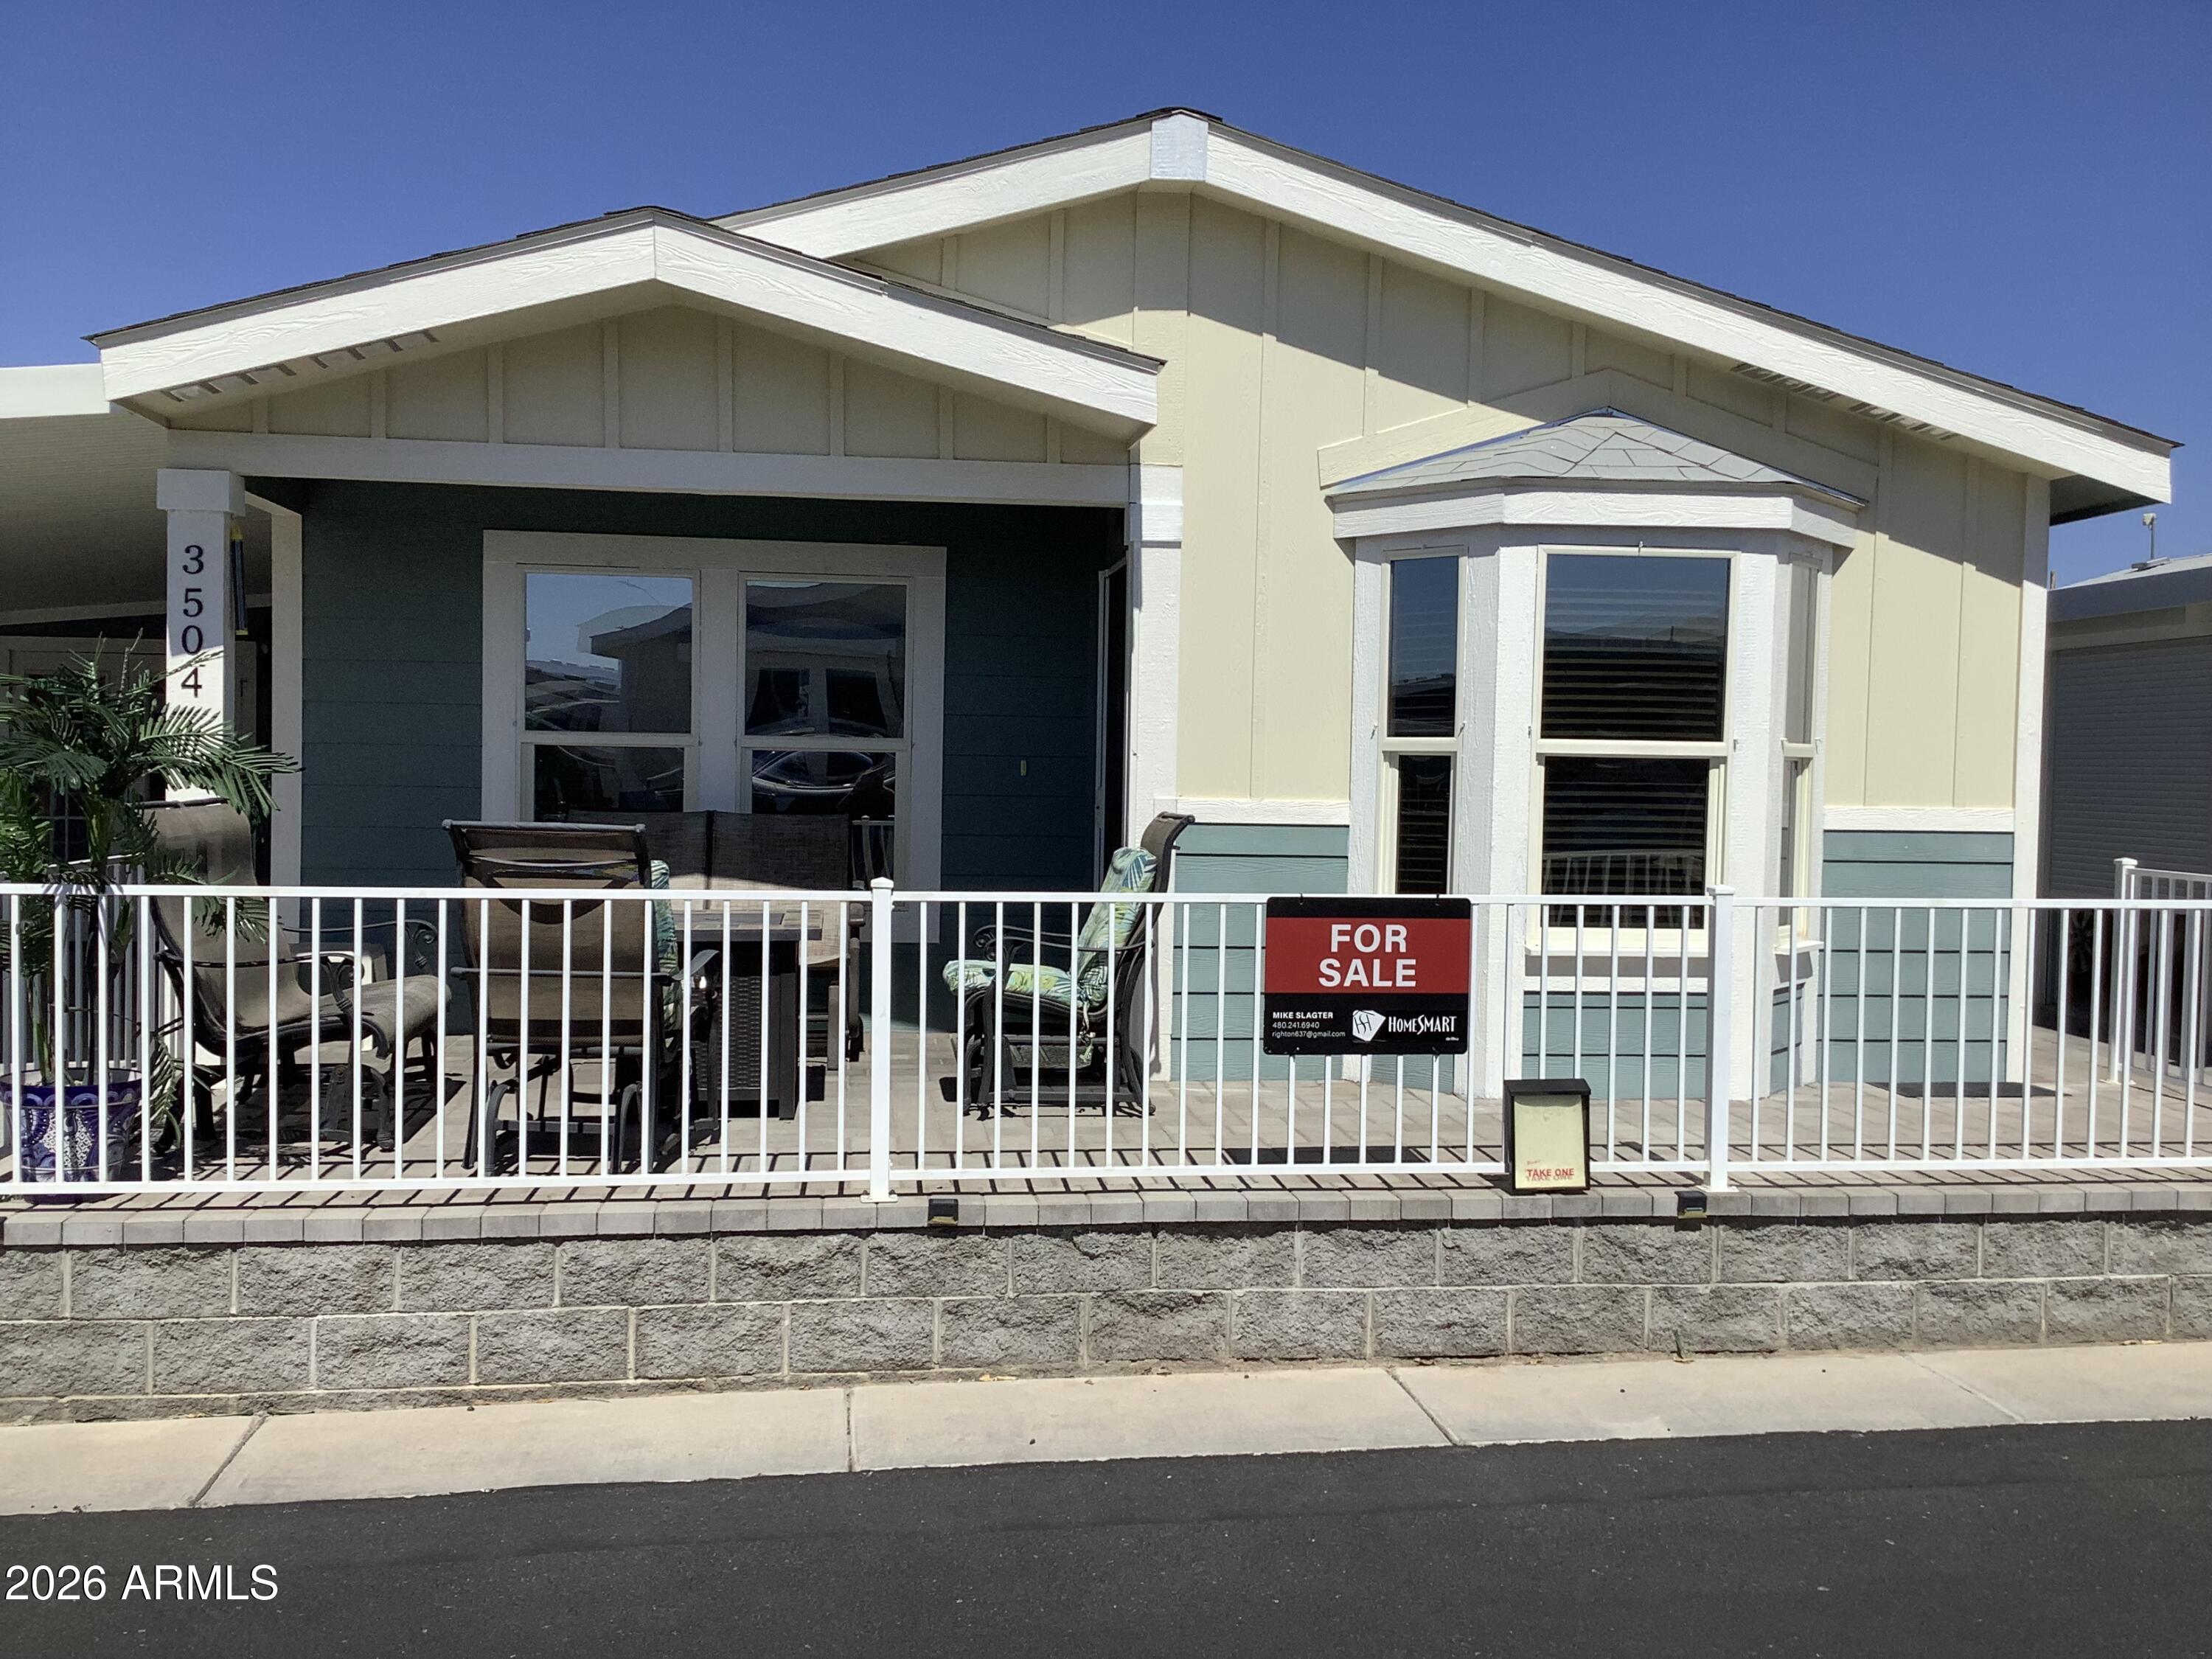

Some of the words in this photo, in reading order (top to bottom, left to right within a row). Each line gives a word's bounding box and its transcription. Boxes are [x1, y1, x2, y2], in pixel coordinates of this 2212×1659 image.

[181, 544, 204, 698] 3504
[1330, 924, 1408, 953] FOR
[1318, 958, 1416, 987] SALE
[1272, 1031, 1346, 1039] righton637@gmail.com
[1526, 1169, 1552, 1178] TAKE
[1554, 1168, 1575, 1177] ONE
